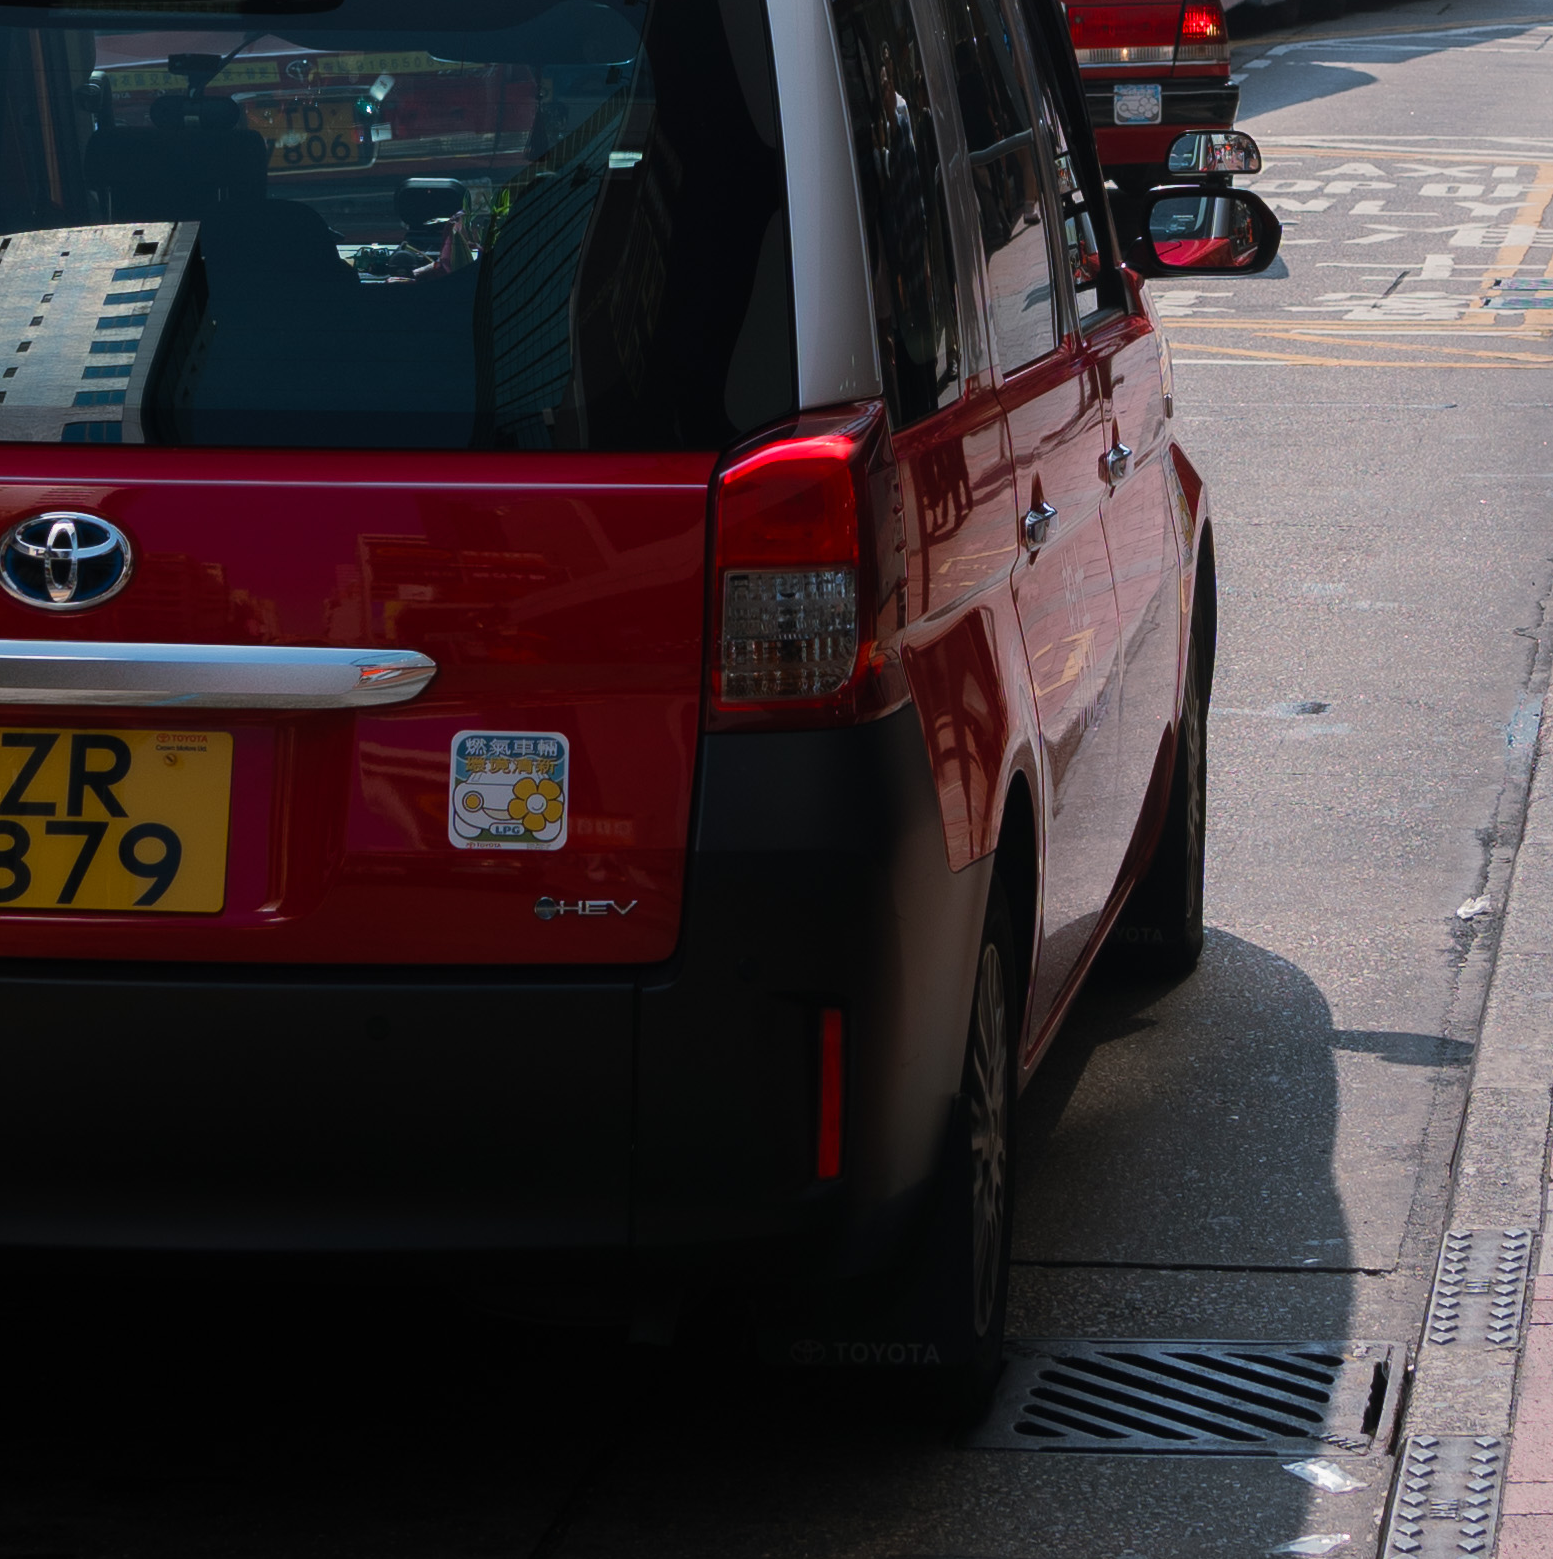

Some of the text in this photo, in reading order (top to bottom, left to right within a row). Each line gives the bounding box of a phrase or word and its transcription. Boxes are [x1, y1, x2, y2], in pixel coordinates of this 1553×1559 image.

[172, 734, 209, 744] TOYOTA
[465, 738, 559, 757] 燃氣車輛
[495, 825, 522, 837] LPG
[558, 899, 639, 916] HEV
